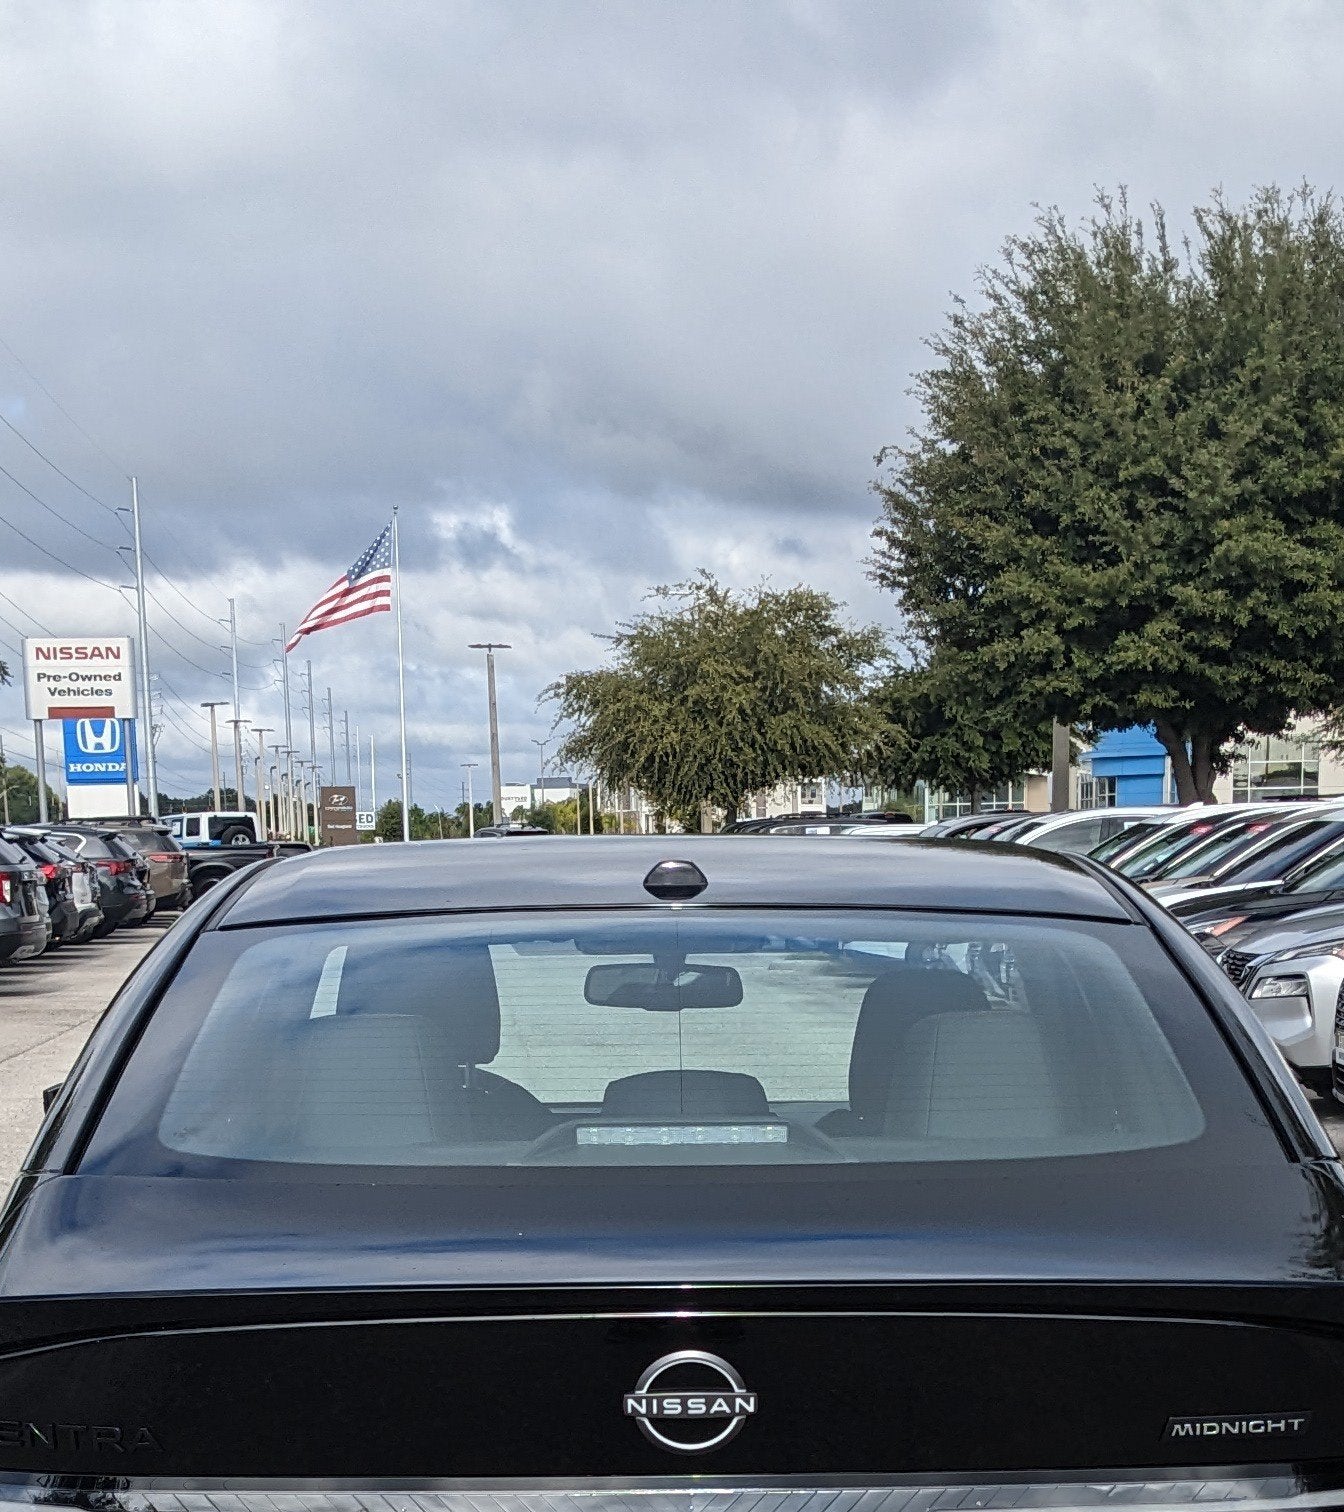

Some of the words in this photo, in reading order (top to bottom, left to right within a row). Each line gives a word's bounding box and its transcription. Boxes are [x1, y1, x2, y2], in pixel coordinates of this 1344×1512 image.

[35, 646, 121, 660] NISSAN
[36, 672, 122, 682] Pre-Owned
[47, 686, 114, 697] Vehicles
[626, 1396, 755, 1415] NISSAN
[1170, 1418, 1306, 1437] MIDNIGHT
